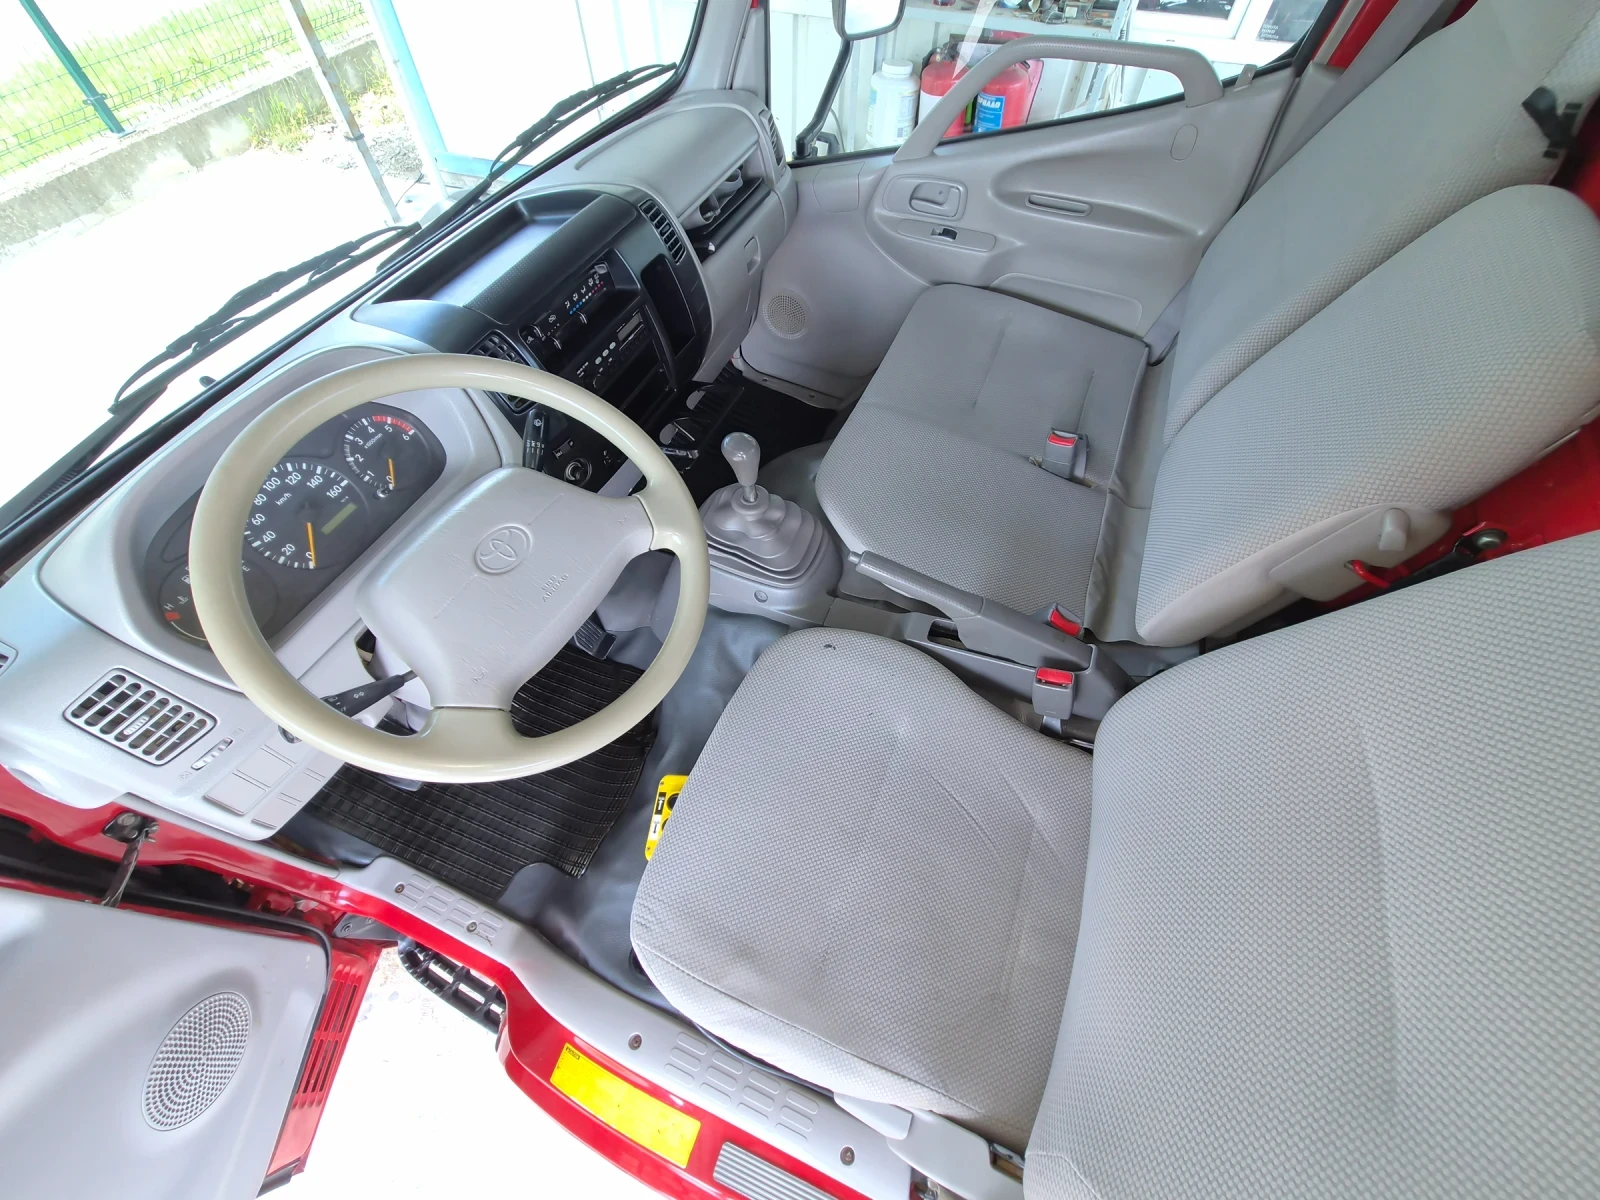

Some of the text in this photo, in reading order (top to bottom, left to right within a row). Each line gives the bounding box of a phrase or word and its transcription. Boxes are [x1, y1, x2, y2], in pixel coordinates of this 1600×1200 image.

[367, 426, 375, 434] 4
[384, 424, 393, 433] 5
[354, 437, 364, 445] 3
[402, 433, 410, 441] 6
[354, 454, 364, 462] 2
[262, 477, 281, 492] 100
[285, 472, 302, 486] 120
[306, 474, 323, 489] 140
[326, 484, 342, 499] 160
[253, 493, 267, 506] 80
[275, 492, 292, 506] km/h
[251, 513, 266, 526] 60
[262, 530, 276, 543] 40
[281, 543, 295, 556] 20
